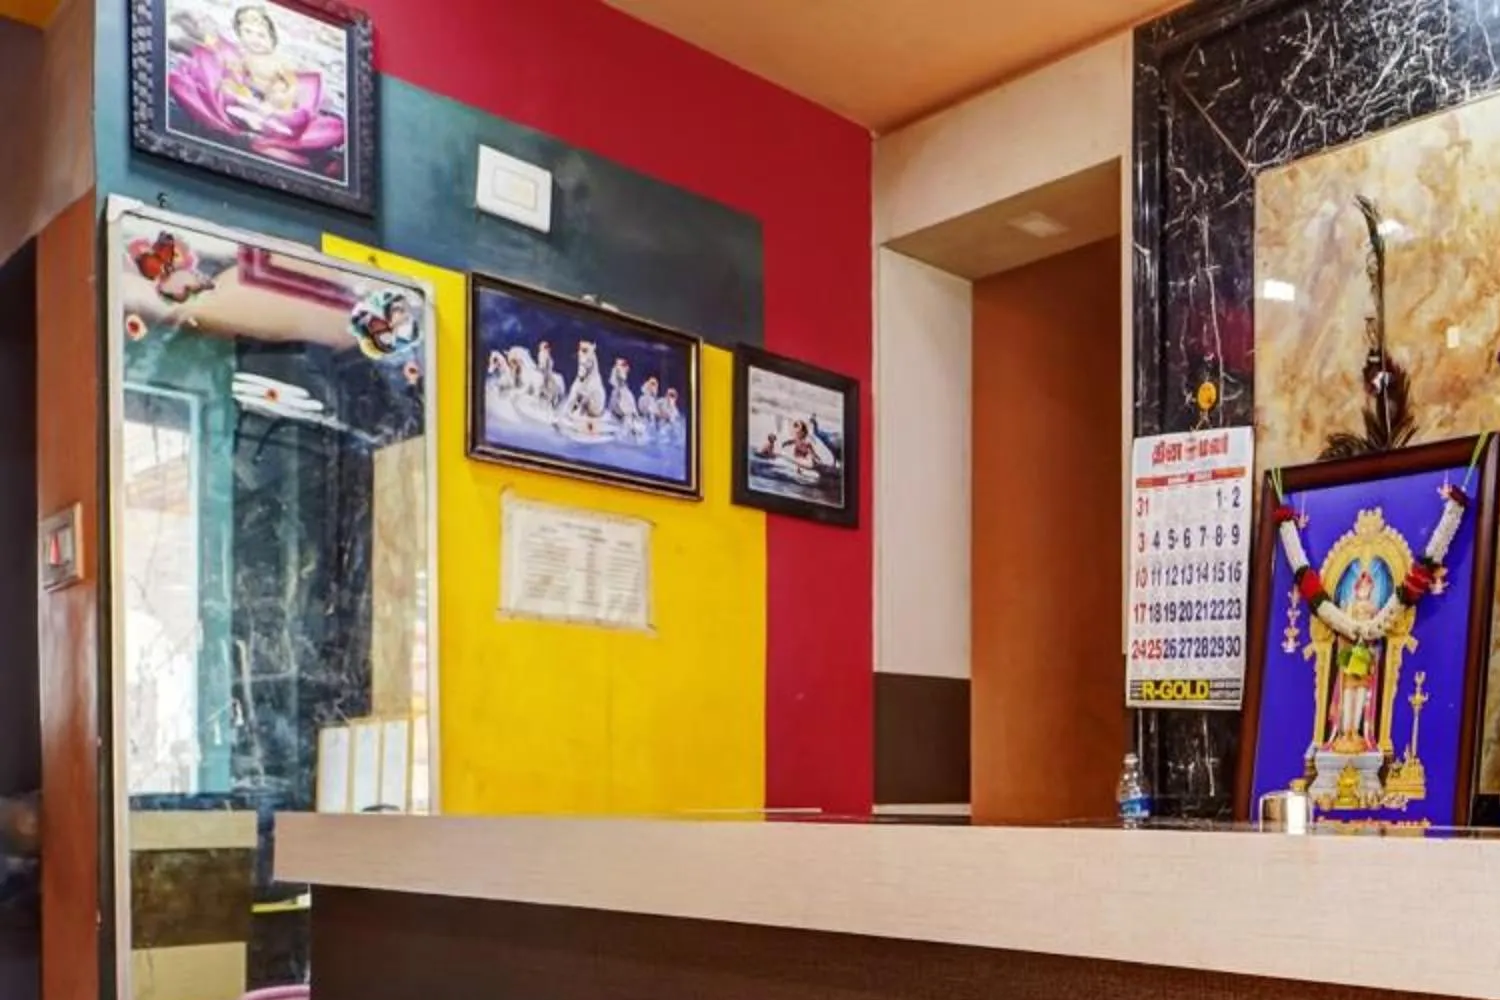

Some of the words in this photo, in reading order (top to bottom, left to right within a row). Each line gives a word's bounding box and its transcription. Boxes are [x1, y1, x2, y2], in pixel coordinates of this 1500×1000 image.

[1136, 496, 1149, 517] 31
[1216, 487, 1223, 509] 1
[1231, 486, 1241, 509] 2
[1138, 532, 1146, 553] 3
[1152, 529, 1161, 550] 4
[1167, 527, 1176, 550] 5
[1183, 527, 1192, 549] 6
[1199, 525, 1207, 547] 7
[1215, 525, 1223, 547] 8
[1231, 524, 1241, 545] 9
[1136, 566, 1148, 589] 10
[1151, 565, 1161, 587] 11
[1165, 564, 1178, 586] 12
[1181, 564, 1193, 585] 13
[1197, 562, 1209, 583] 14
[1212, 562, 1225, 583] 15
[1228, 562, 1242, 583] 16
[1133, 603, 1147, 624] 17
[1149, 602, 1161, 623] 18
[1164, 602, 1176, 623] 19
[1179, 600, 1193, 622] 20
[1195, 600, 1209, 621] 21
[1210, 599, 1225, 621] 22
[1227, 598, 1241, 620] 23
[1132, 639, 1147, 660] 24
[1148, 639, 1162, 660] 25
[1163, 637, 1177, 659] 26
[1178, 637, 1192, 659] 27
[1194, 636, 1208, 659] 28
[1210, 636, 1224, 658] 29
[1226, 635, 1241, 658] 30
[1142, 679, 1210, 701] R-GOLD
